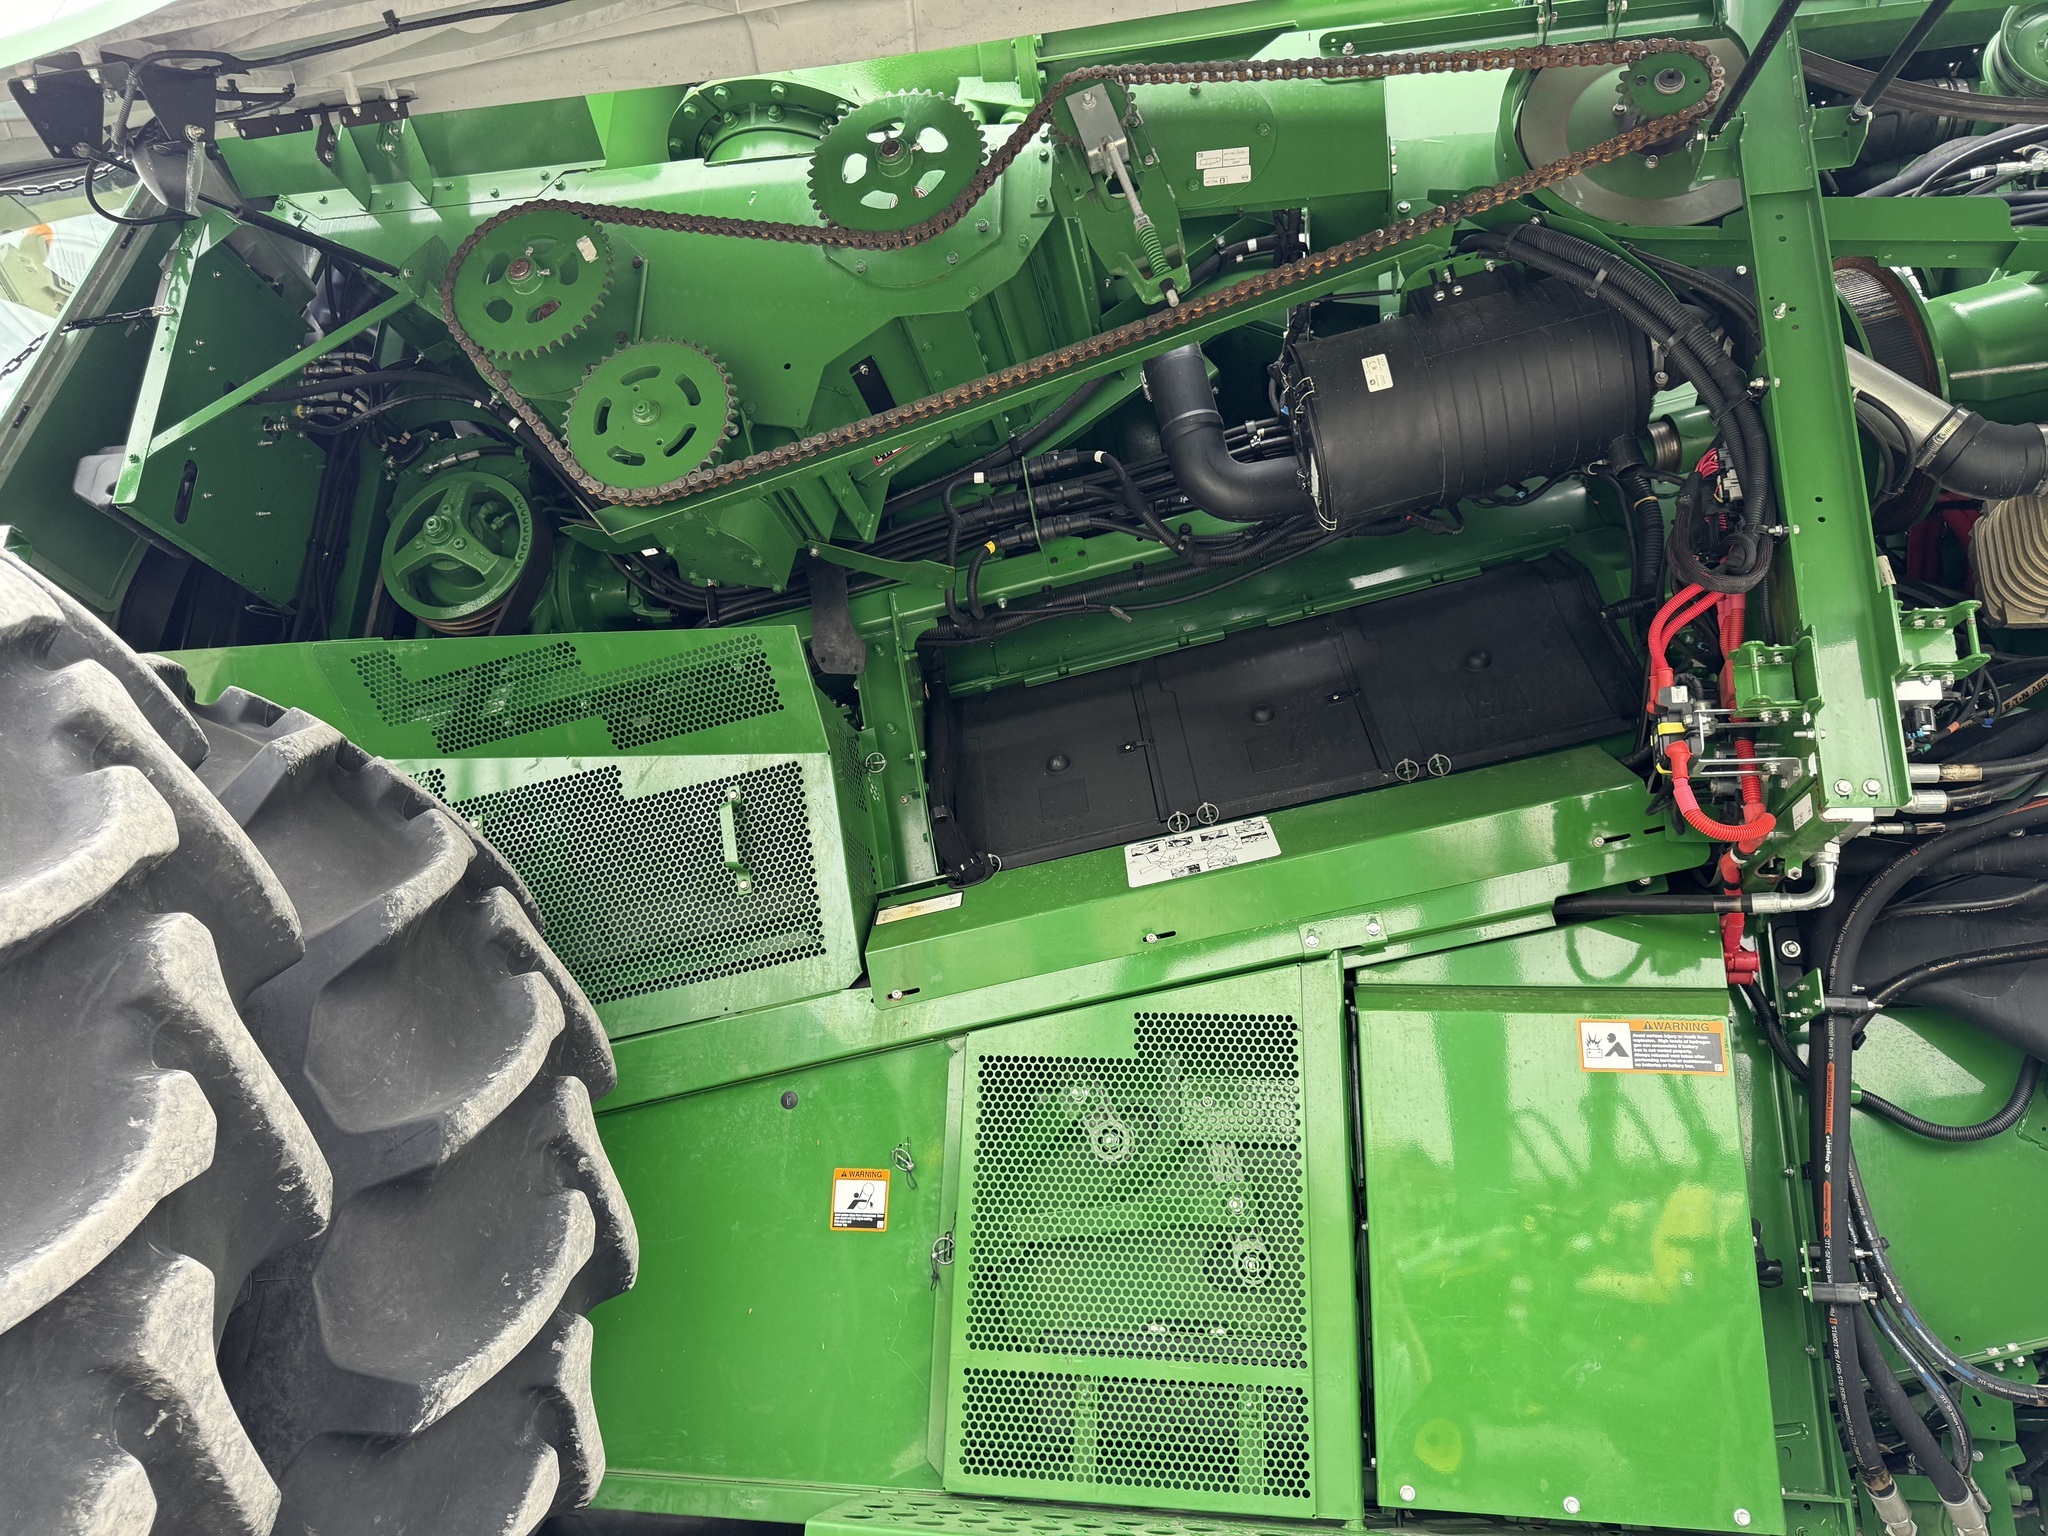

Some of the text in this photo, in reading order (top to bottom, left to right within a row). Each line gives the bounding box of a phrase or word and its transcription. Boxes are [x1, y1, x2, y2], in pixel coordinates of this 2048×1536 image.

[1653, 1021, 1709, 1031] WARNING
[1831, 1325, 1839, 1348] 100R15
[1833, 1347, 1841, 1360] SAE
[1837, 1375, 1845, 1387] R15
